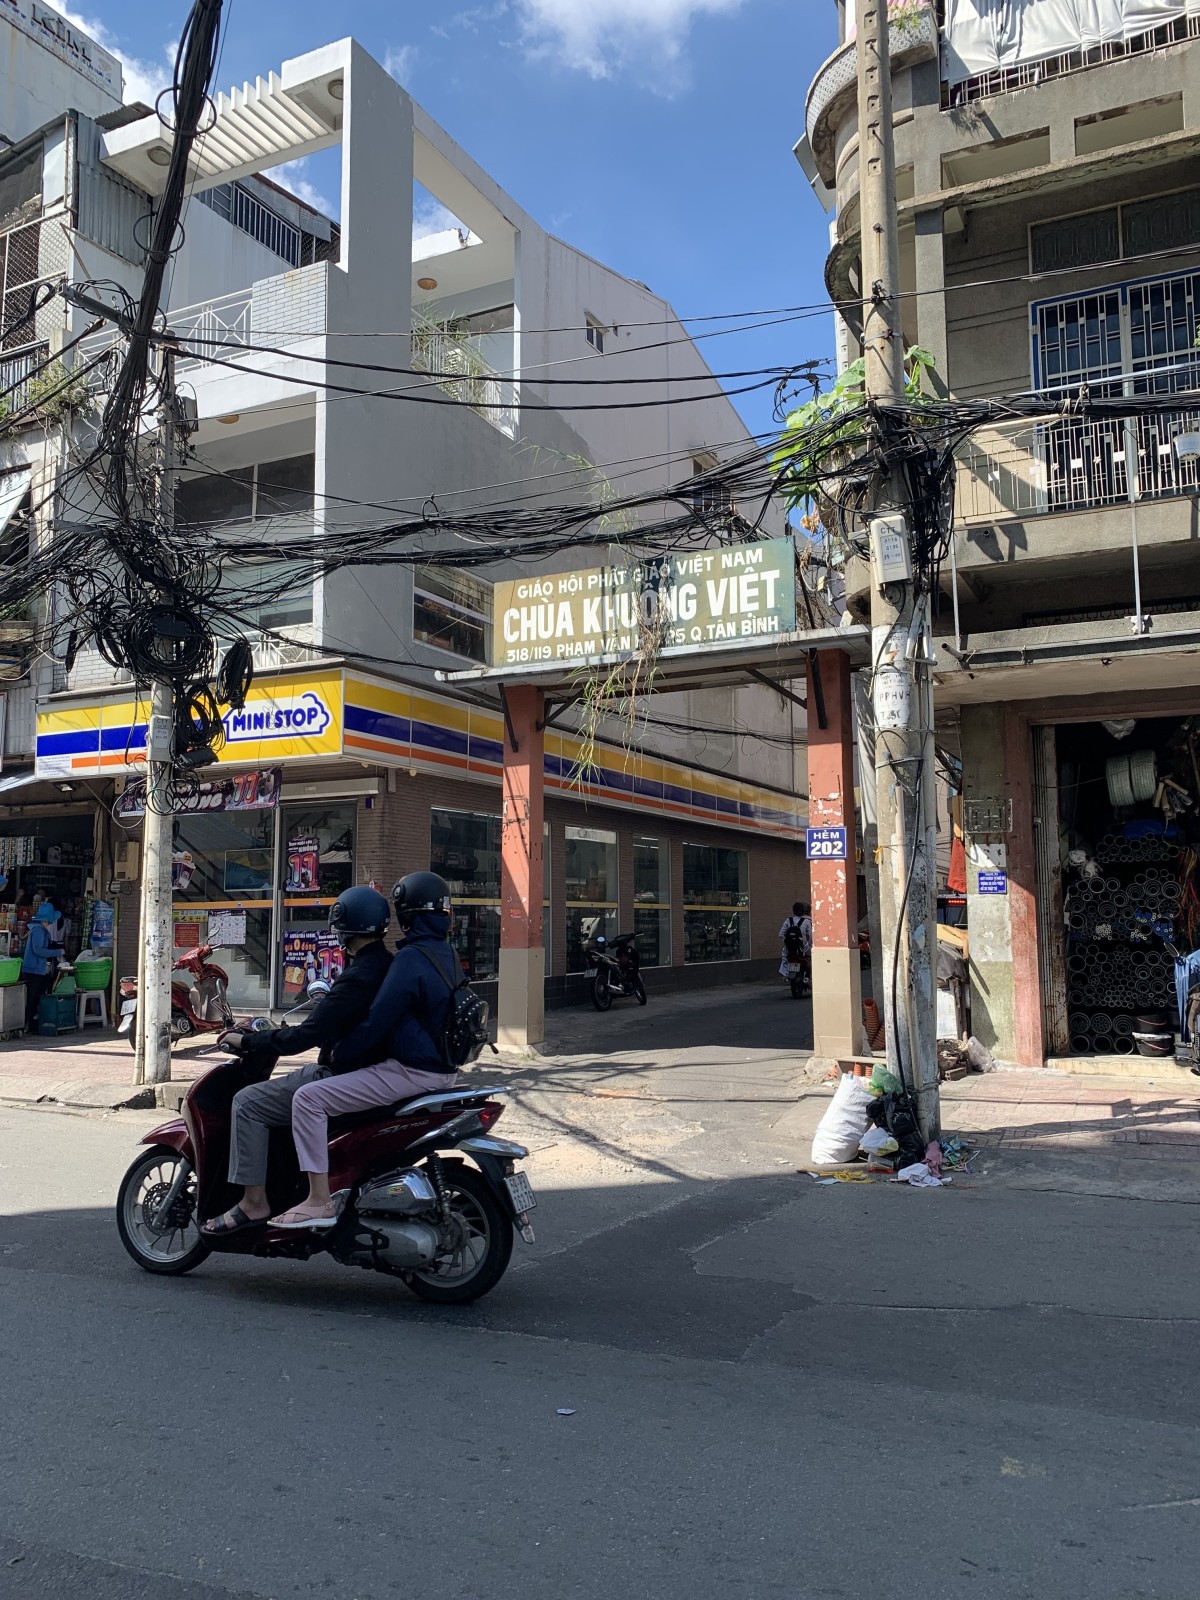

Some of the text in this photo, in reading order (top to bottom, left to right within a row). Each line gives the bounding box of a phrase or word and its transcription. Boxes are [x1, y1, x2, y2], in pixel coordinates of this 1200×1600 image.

[517, 579, 554, 599] GIÁO
[558, 574, 583, 596] HỘI
[677, 554, 714, 577] VIỆT
[722, 548, 763, 569] NAM
[503, 567, 781, 643] CHÙA KHUÔNG VIỆT
[506, 645, 552, 663] 318/119
[556, 639, 595, 657] PHẠM
[741, 615, 779, 636] BÌNH
[810, 840, 843, 856] 202
